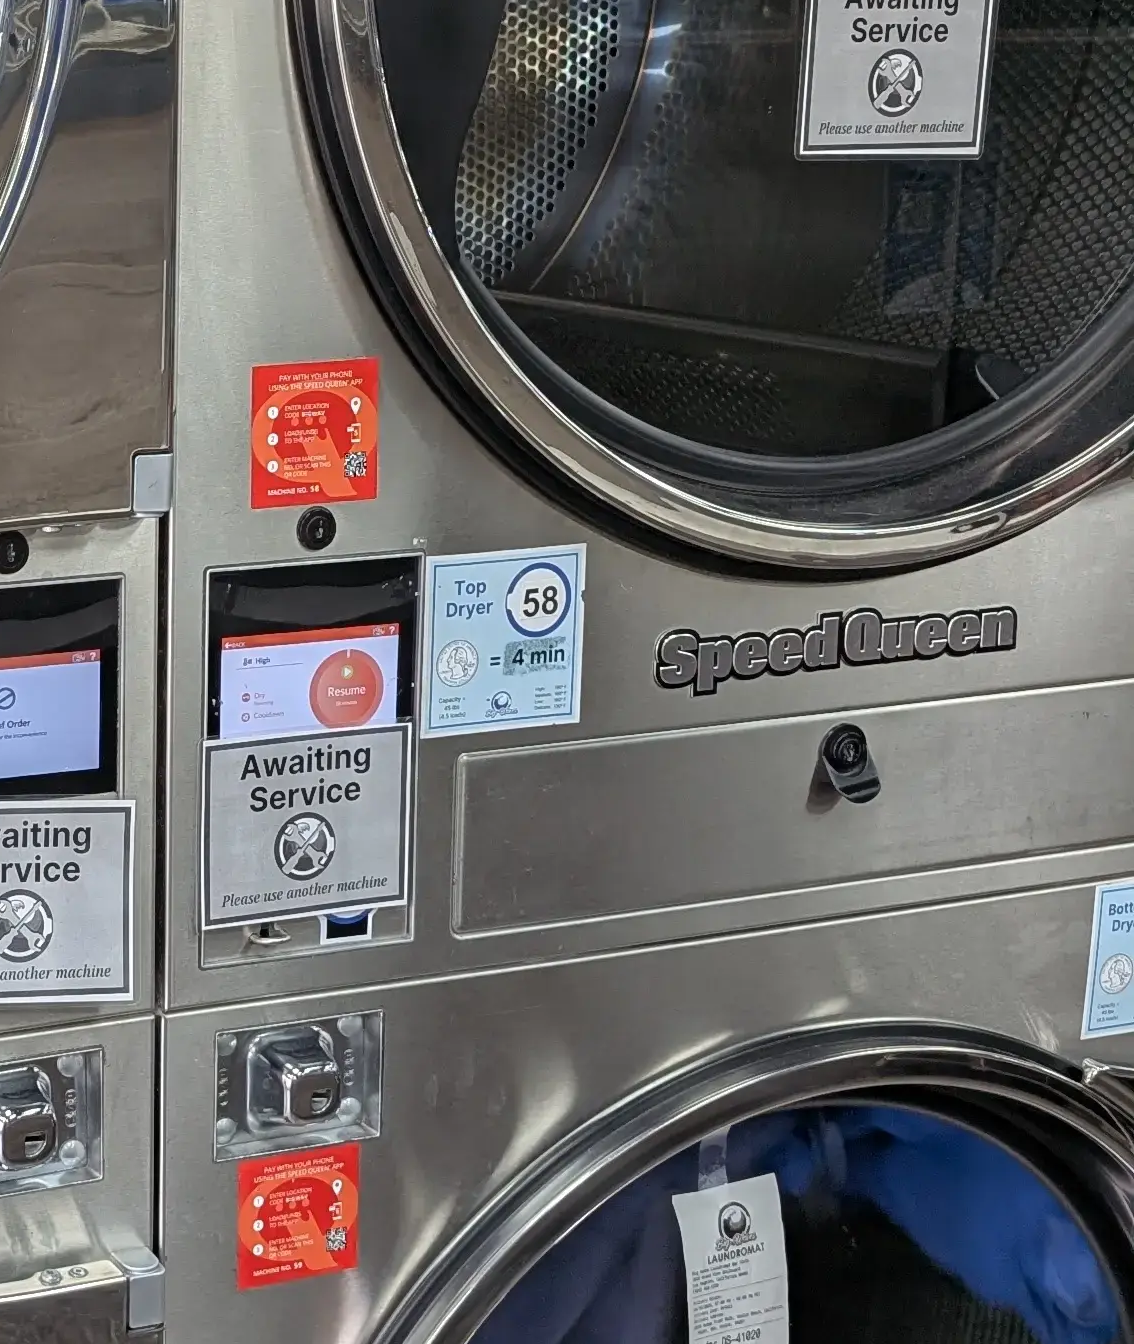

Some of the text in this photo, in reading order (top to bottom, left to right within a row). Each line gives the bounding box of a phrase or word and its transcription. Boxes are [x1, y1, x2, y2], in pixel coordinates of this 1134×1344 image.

[850, 16, 949, 43] Service
[818, 120, 965, 136] Please use another machine
[454, 580, 487, 598] Top
[446, 601, 494, 621] Dryer
[523, 585, 559, 618] 58
[255, 657, 271, 665] High
[512, 649, 524, 666] 4
[530, 644, 565, 665] min
[654, 605, 1016, 697] Speed Queen
[327, 686, 366, 698] Resume
[7, 719, 31, 729] Order
[240, 744, 372, 781] Awaiting
[249, 778, 361, 813] Service
[221, 875, 388, 908] Please use another machine
[1111, 919, 1134, 934] Dry
[0, 966, 54, 981] another
[55, 964, 112, 979] machine
[707, 1242, 765, 1265] LAUNDROMAT
